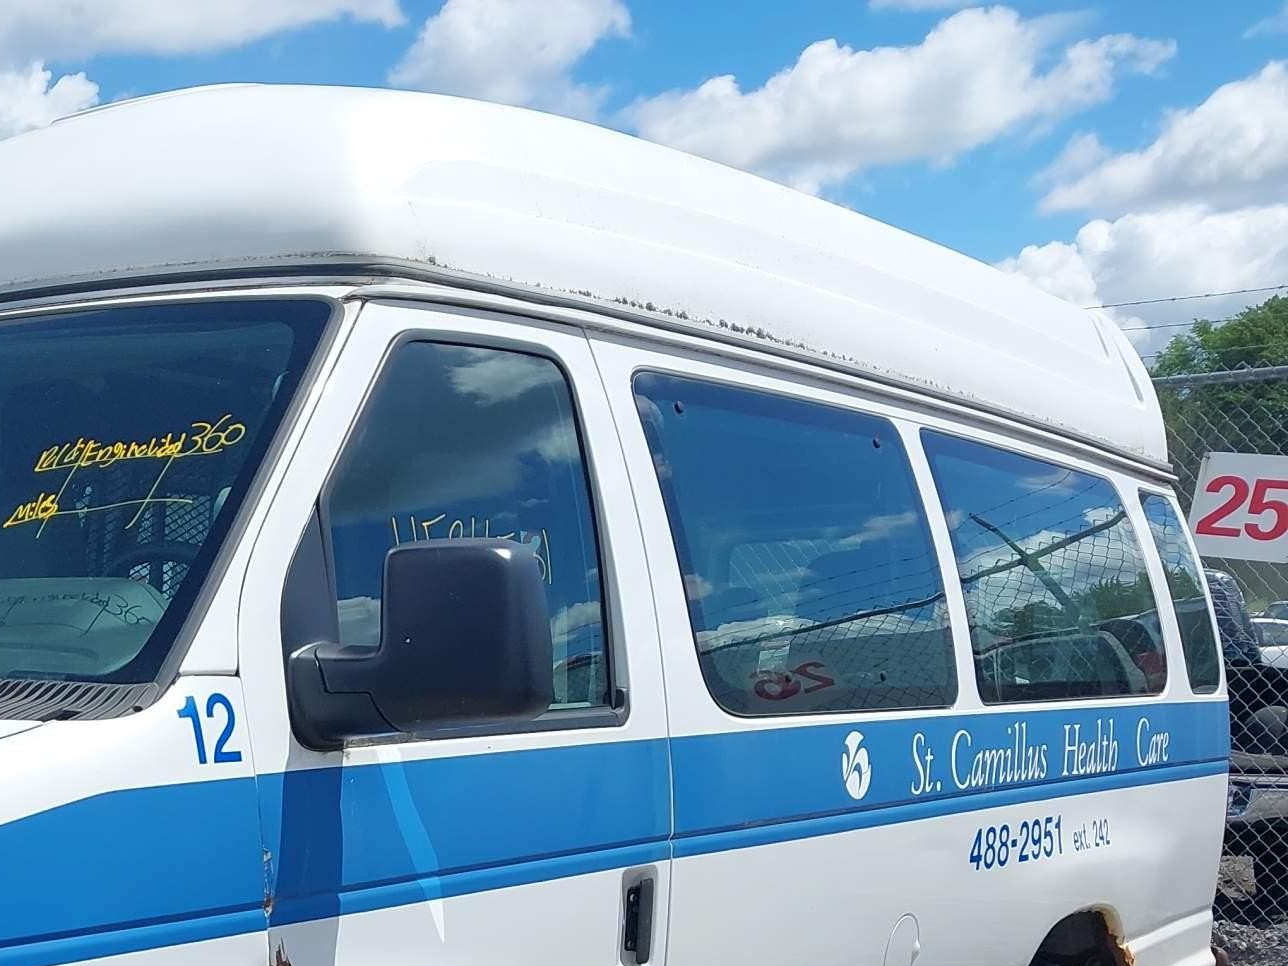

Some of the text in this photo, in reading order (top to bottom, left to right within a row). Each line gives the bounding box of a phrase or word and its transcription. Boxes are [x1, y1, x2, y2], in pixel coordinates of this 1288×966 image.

[184, 413, 246, 453] 360
[1195, 475, 1288, 542] 25
[176, 692, 243, 765] 12
[911, 717, 1170, 796] St. Camillus Health Care
[969, 814, 1111, 871] 488-2951 ext. 242
